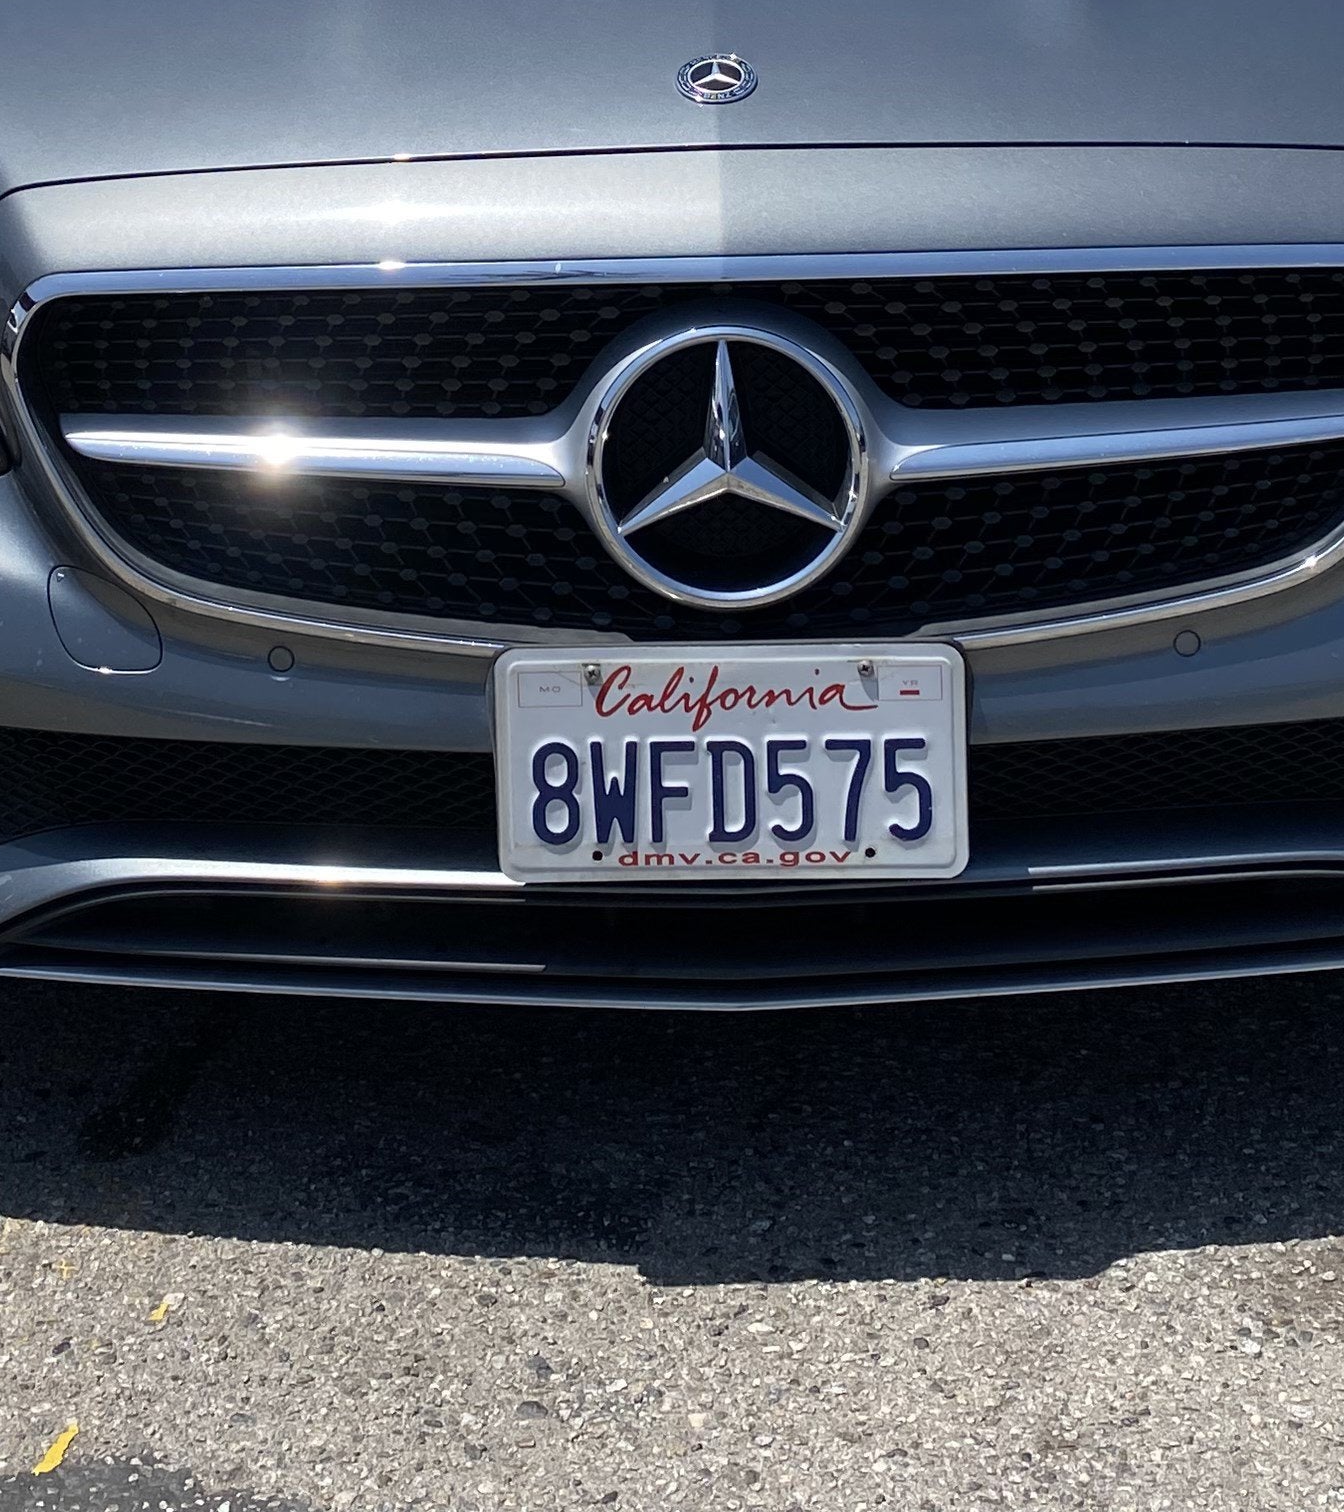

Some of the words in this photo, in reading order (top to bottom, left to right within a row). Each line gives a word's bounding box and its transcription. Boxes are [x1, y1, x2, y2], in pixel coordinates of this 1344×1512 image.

[594, 664, 879, 732] California
[531, 737, 934, 845] 8WFD575
[618, 848, 853, 868] dmv.ca.gov
